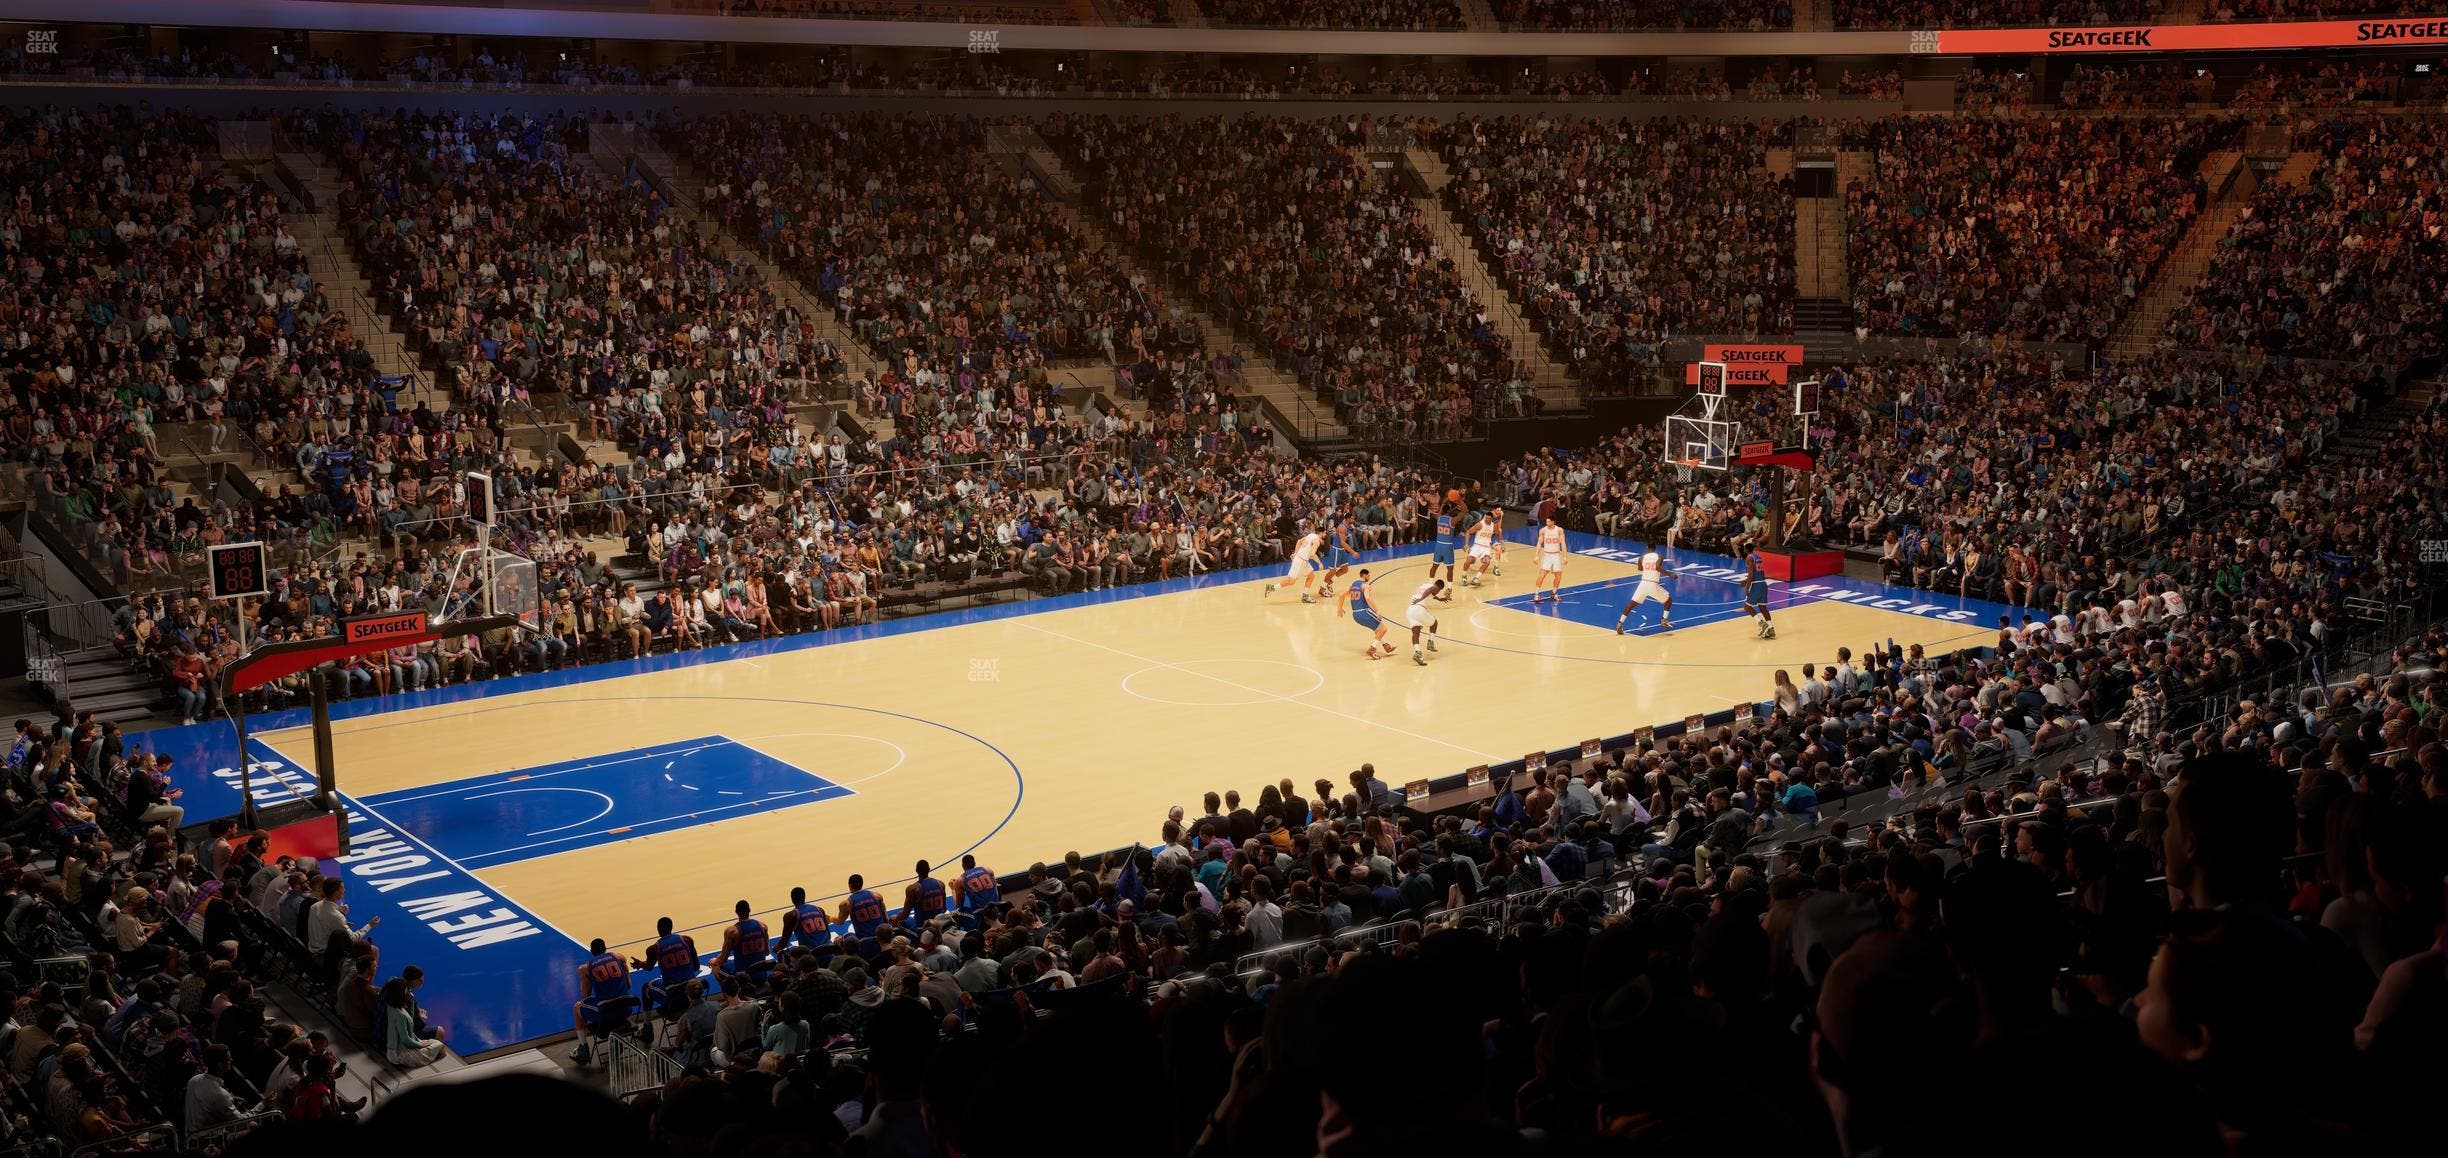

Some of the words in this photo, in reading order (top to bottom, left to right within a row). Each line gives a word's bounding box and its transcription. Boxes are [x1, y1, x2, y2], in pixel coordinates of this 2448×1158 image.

[2048, 29, 2152, 48] SEATGEEK
[1721, 350, 1787, 362] SEATGEEK
[1726, 369, 1770, 381] TGEEK
[1744, 446, 1769, 455] SEATGEEK
[225, 566, 253, 591] 88
[1788, 584, 1977, 620] KNICKS
[354, 618, 418, 638] SEATGEEK
[967, 874, 993, 892] 00
[397, 890, 542, 950] NEW
[855, 905, 880, 922] 00
[802, 917, 826, 933] 00
[662, 950, 689, 969] 00
[591, 961, 622, 982] 00
